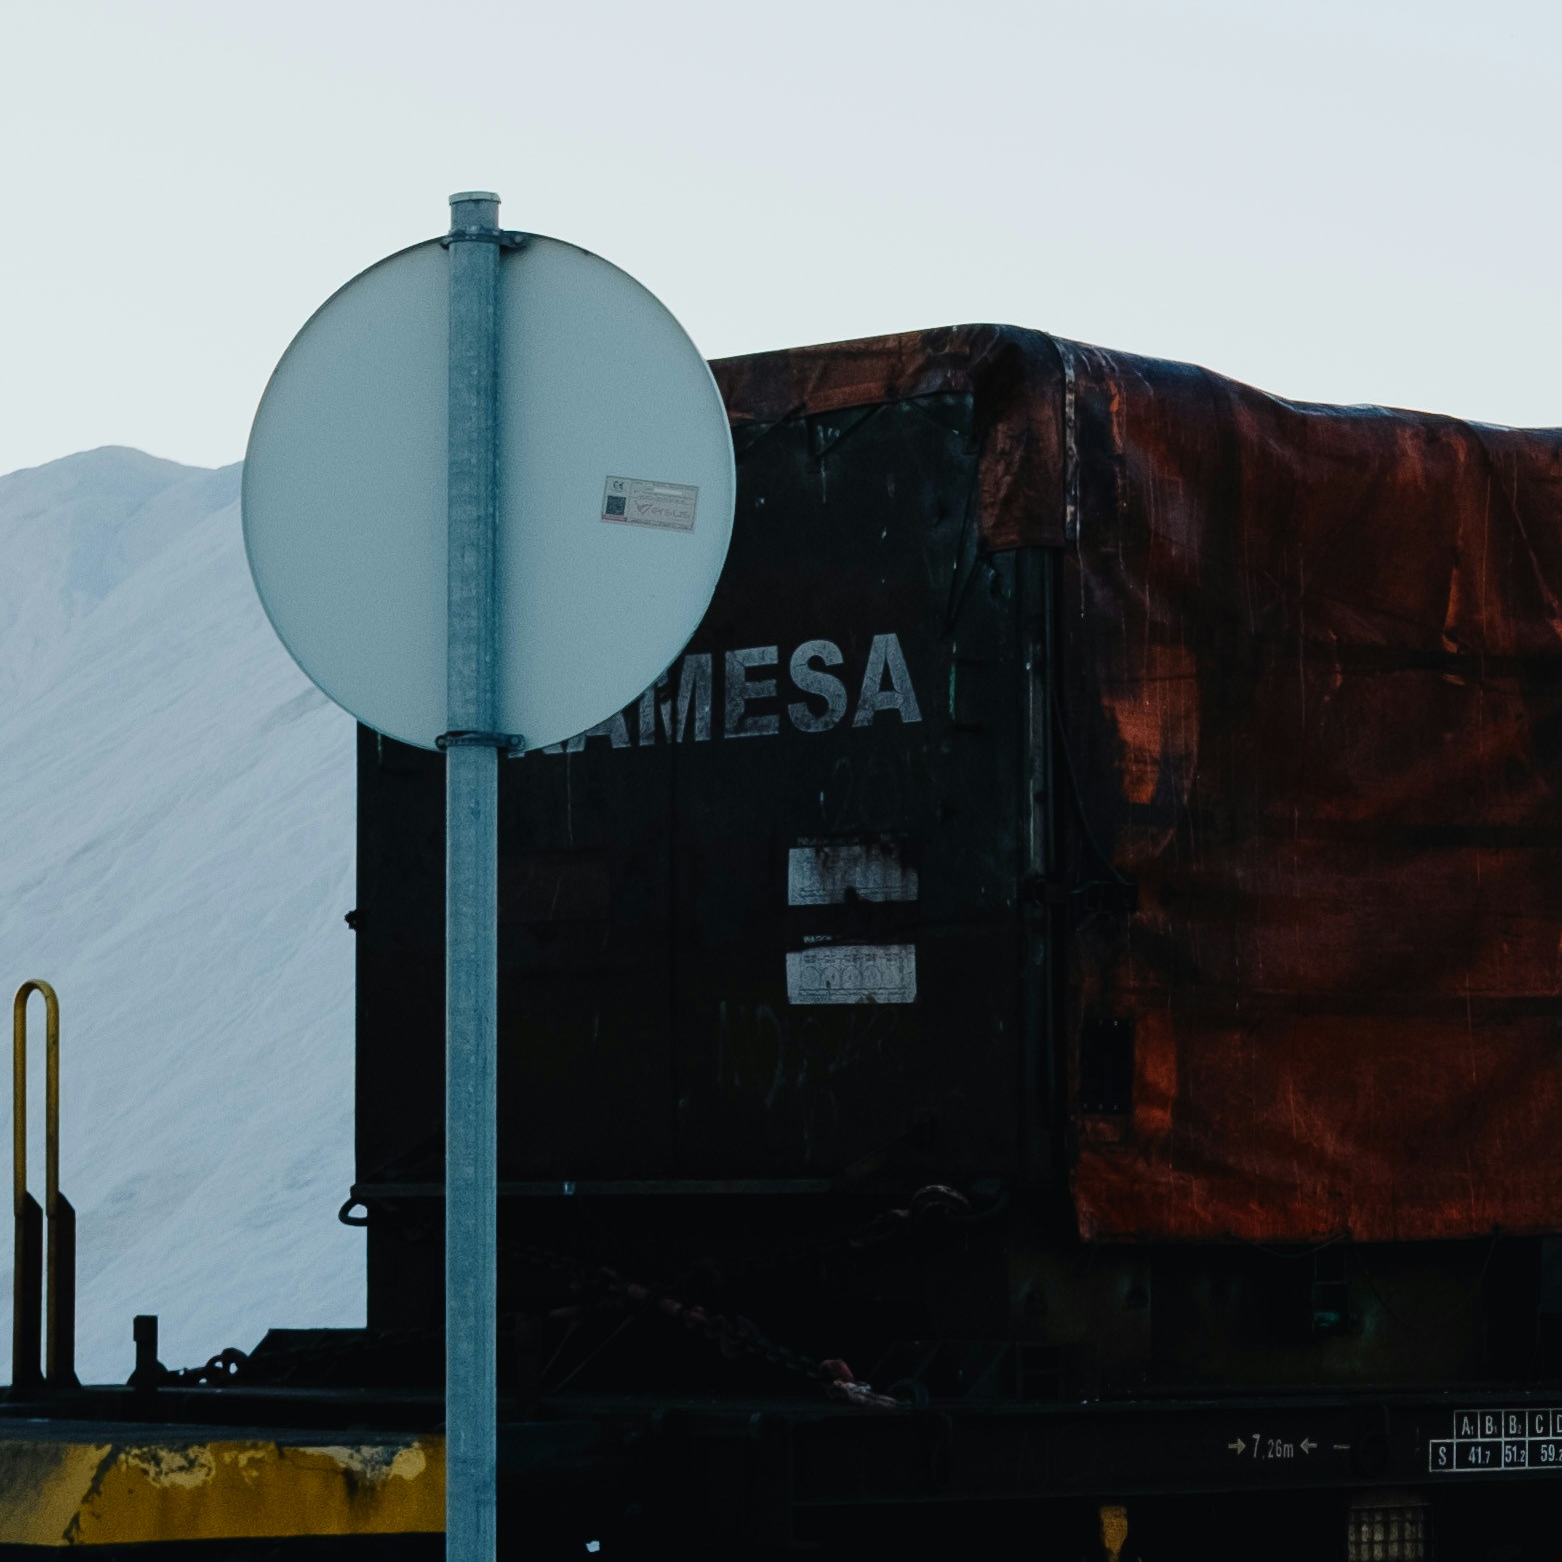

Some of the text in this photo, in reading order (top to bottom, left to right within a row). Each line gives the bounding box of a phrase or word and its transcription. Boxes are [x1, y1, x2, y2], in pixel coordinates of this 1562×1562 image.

[1438, 1446, 1447, 1466] S
[1468, 1446, 1491, 1465] 41.7
[1505, 1445, 1526, 1463] 51.2
